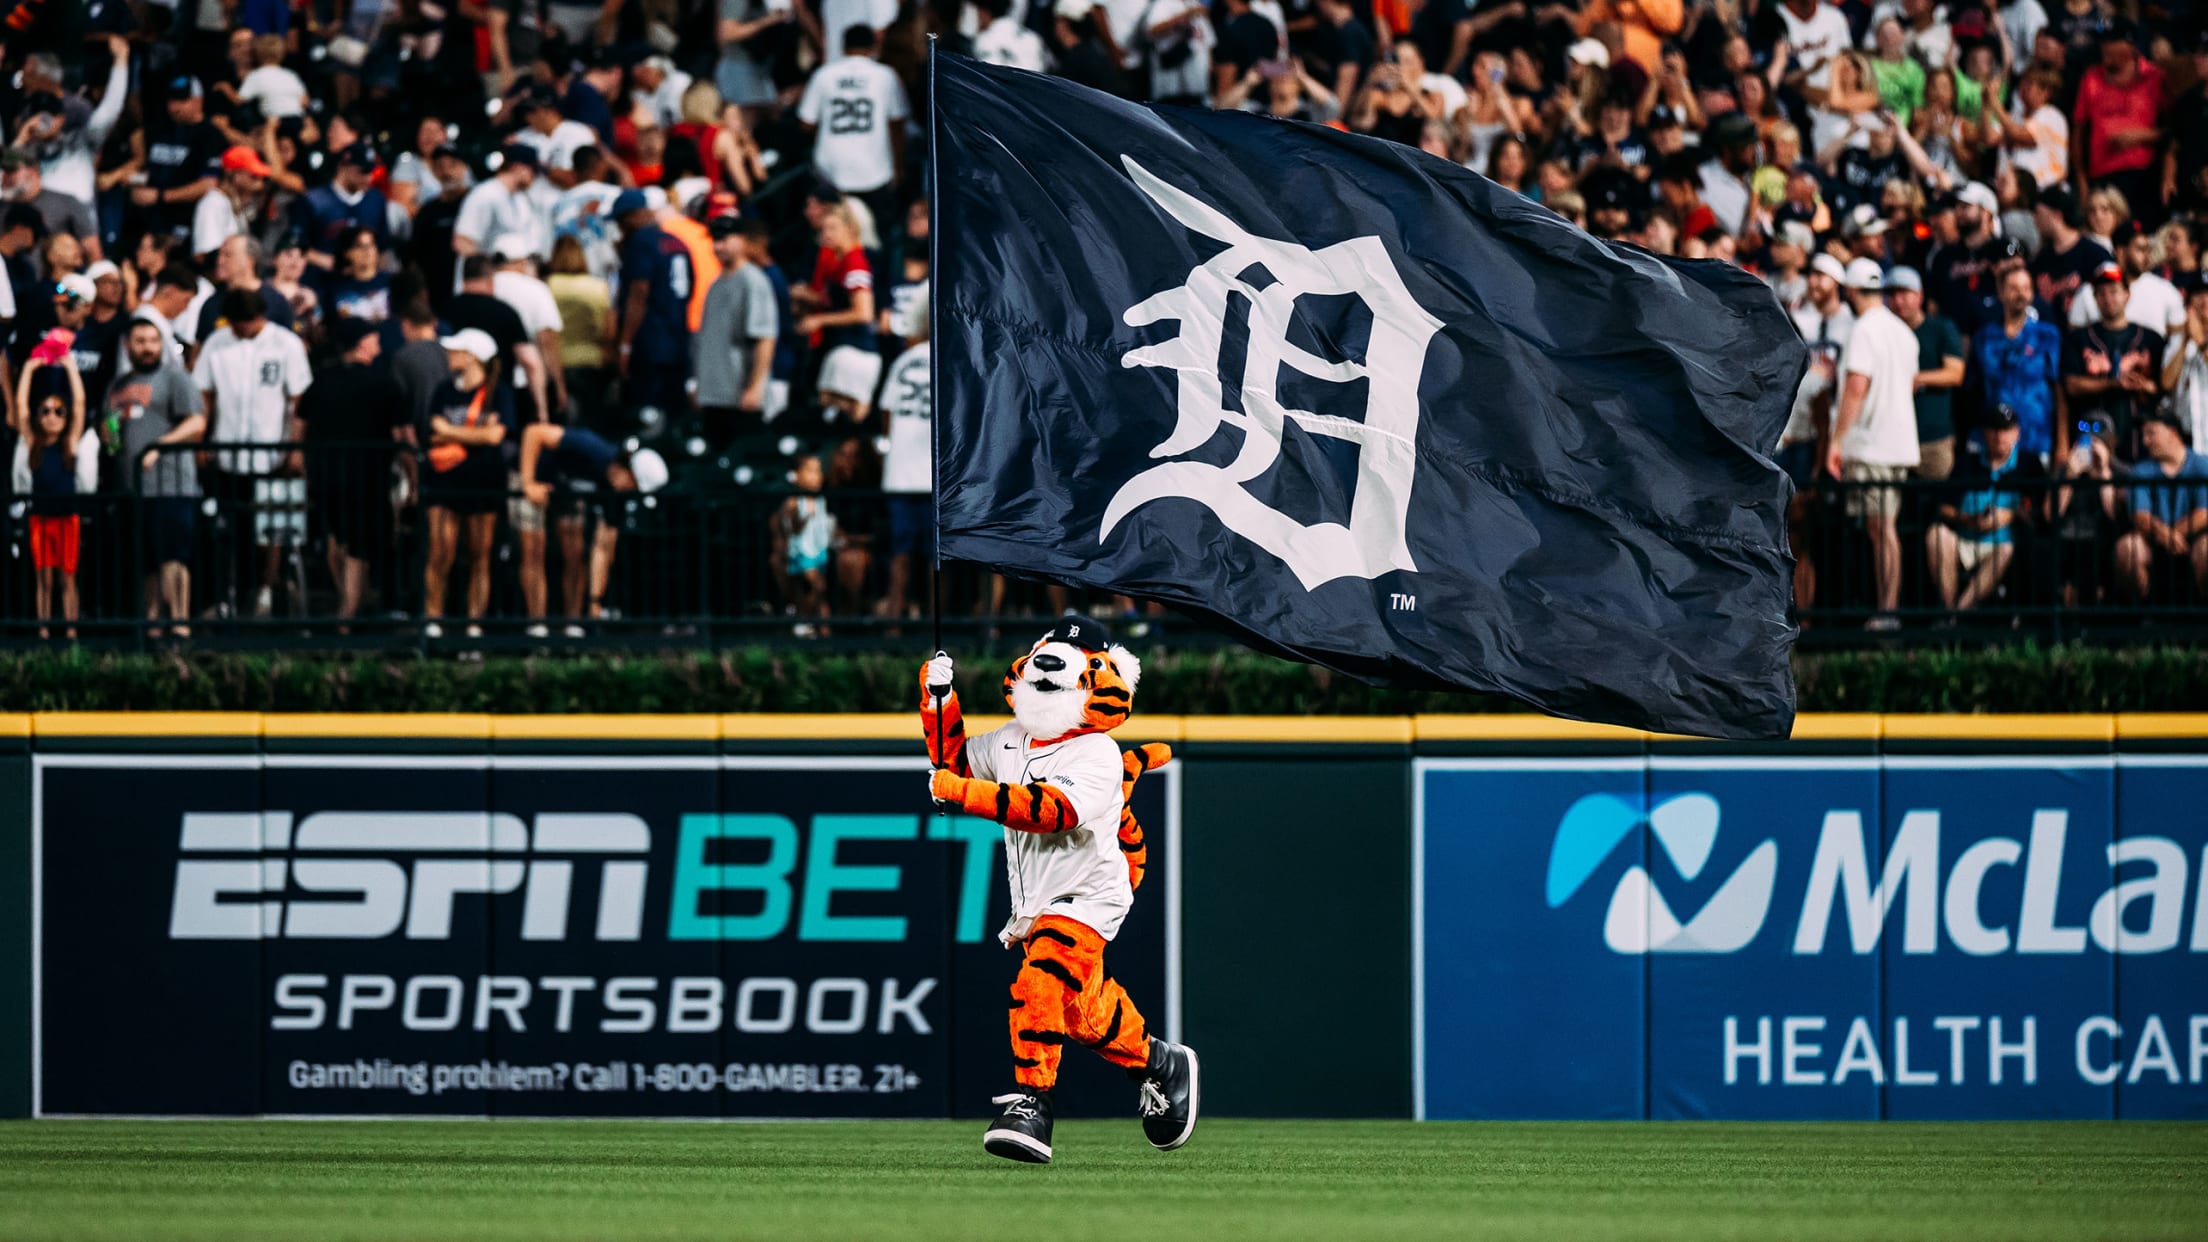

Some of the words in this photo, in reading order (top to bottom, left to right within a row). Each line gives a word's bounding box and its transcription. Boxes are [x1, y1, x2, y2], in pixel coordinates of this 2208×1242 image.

[831, 97, 874, 134] 28
[1100, 154, 1446, 592] D
[1390, 593, 1416, 611] TM
[169, 811, 651, 940] ESPN
[668, 812, 1004, 943] BET
[272, 975, 936, 1034] SPORTSBOOK
[289, 1060, 428, 1094] Gambling
[433, 1060, 569, 1093] problem?
[574, 1062, 627, 1091] Call
[633, 1063, 869, 1092] 1-800-GAMBLER.
[874, 1065, 919, 1092] 21+
[1725, 1017, 2036, 1084] HEALTH
